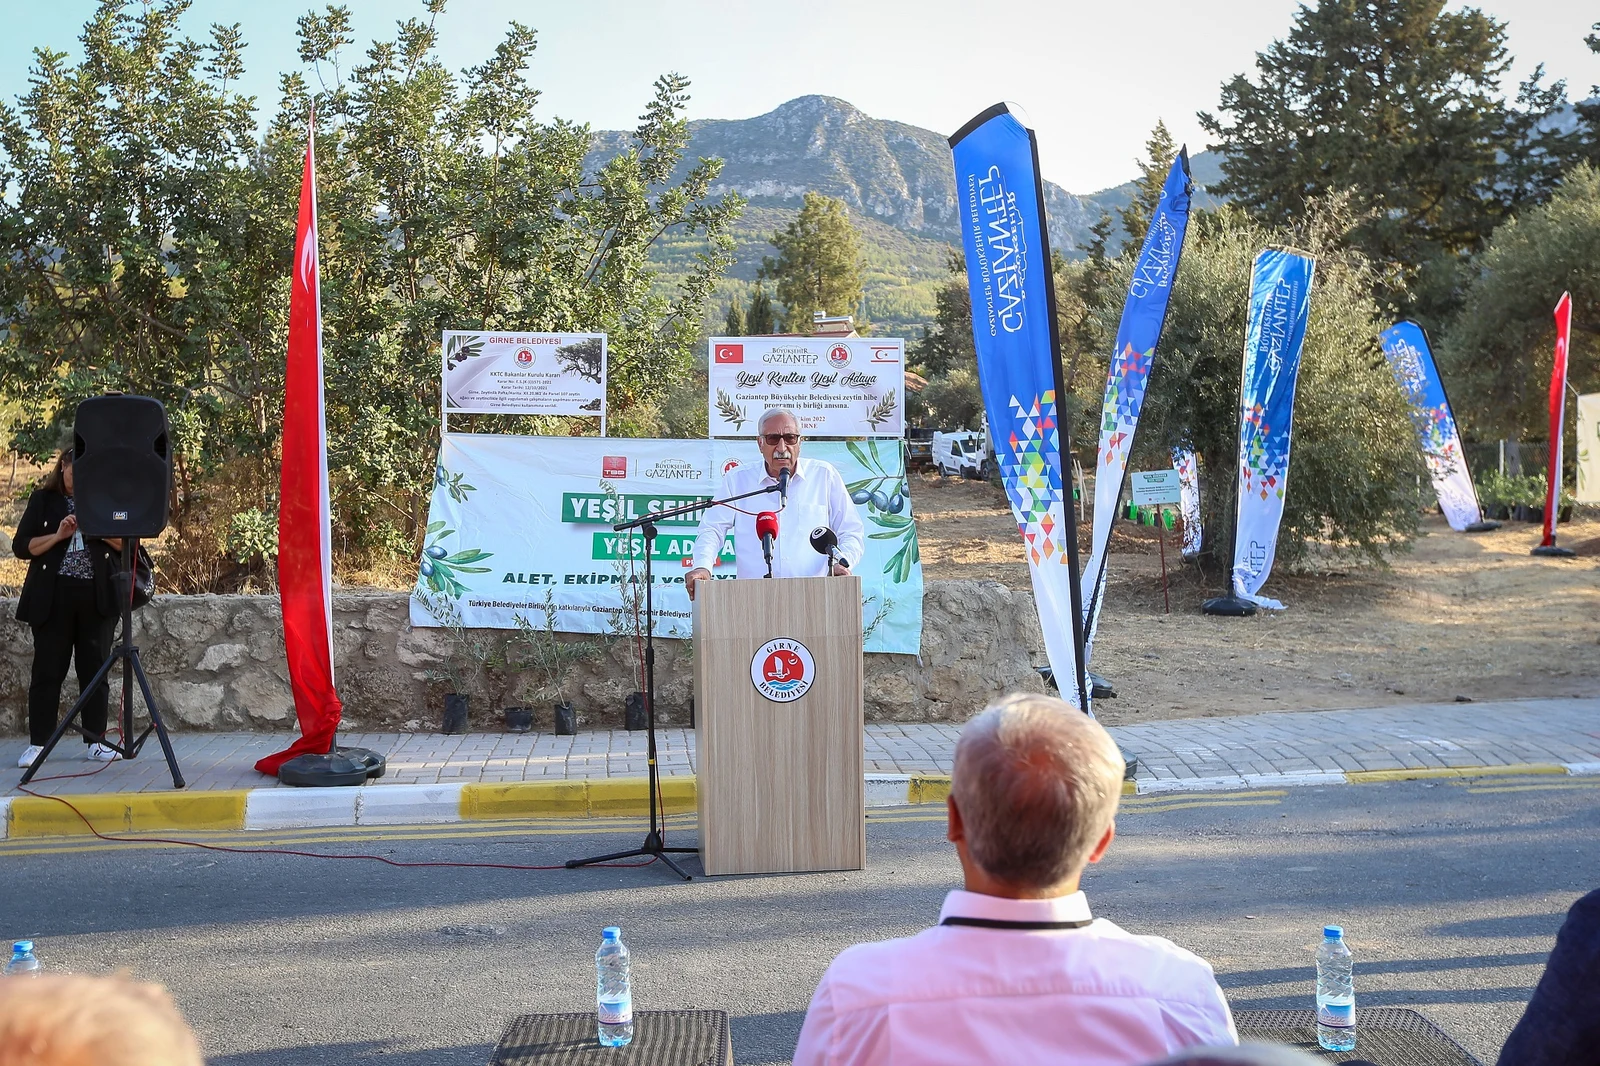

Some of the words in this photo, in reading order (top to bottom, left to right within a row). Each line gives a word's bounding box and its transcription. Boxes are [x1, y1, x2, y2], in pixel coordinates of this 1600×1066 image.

[489, 336, 514, 344] GİRNE
[516, 336, 562, 345] BELEDİYESİ
[762, 353, 819, 364] GAZİANTEP
[736, 370, 764, 388] Yeşil
[767, 371, 806, 388] Kentten
[810, 371, 837, 388] Yeşil
[841, 371, 877, 388] Adaya
[735, 393, 769, 402] Gaziantep
[770, 393, 807, 402] Büyükşehir
[809, 394, 841, 402] Belediyesi
[803, 402, 823, 410] birliği
[655, 462, 692, 470] BÜYÜKŞEHİR
[645, 469, 702, 480] GAZİANTEP
[570, 495, 639, 522] YEŞİL
[502, 572, 557, 586] ALET,
[468, 600, 491, 609] Türkiye
[492, 600, 527, 609] Belediyeler
[558, 603, 591, 613] katkılarıyla
[592, 605, 623, 614] Gaziantep
[766, 642, 800, 653] GİRNE
